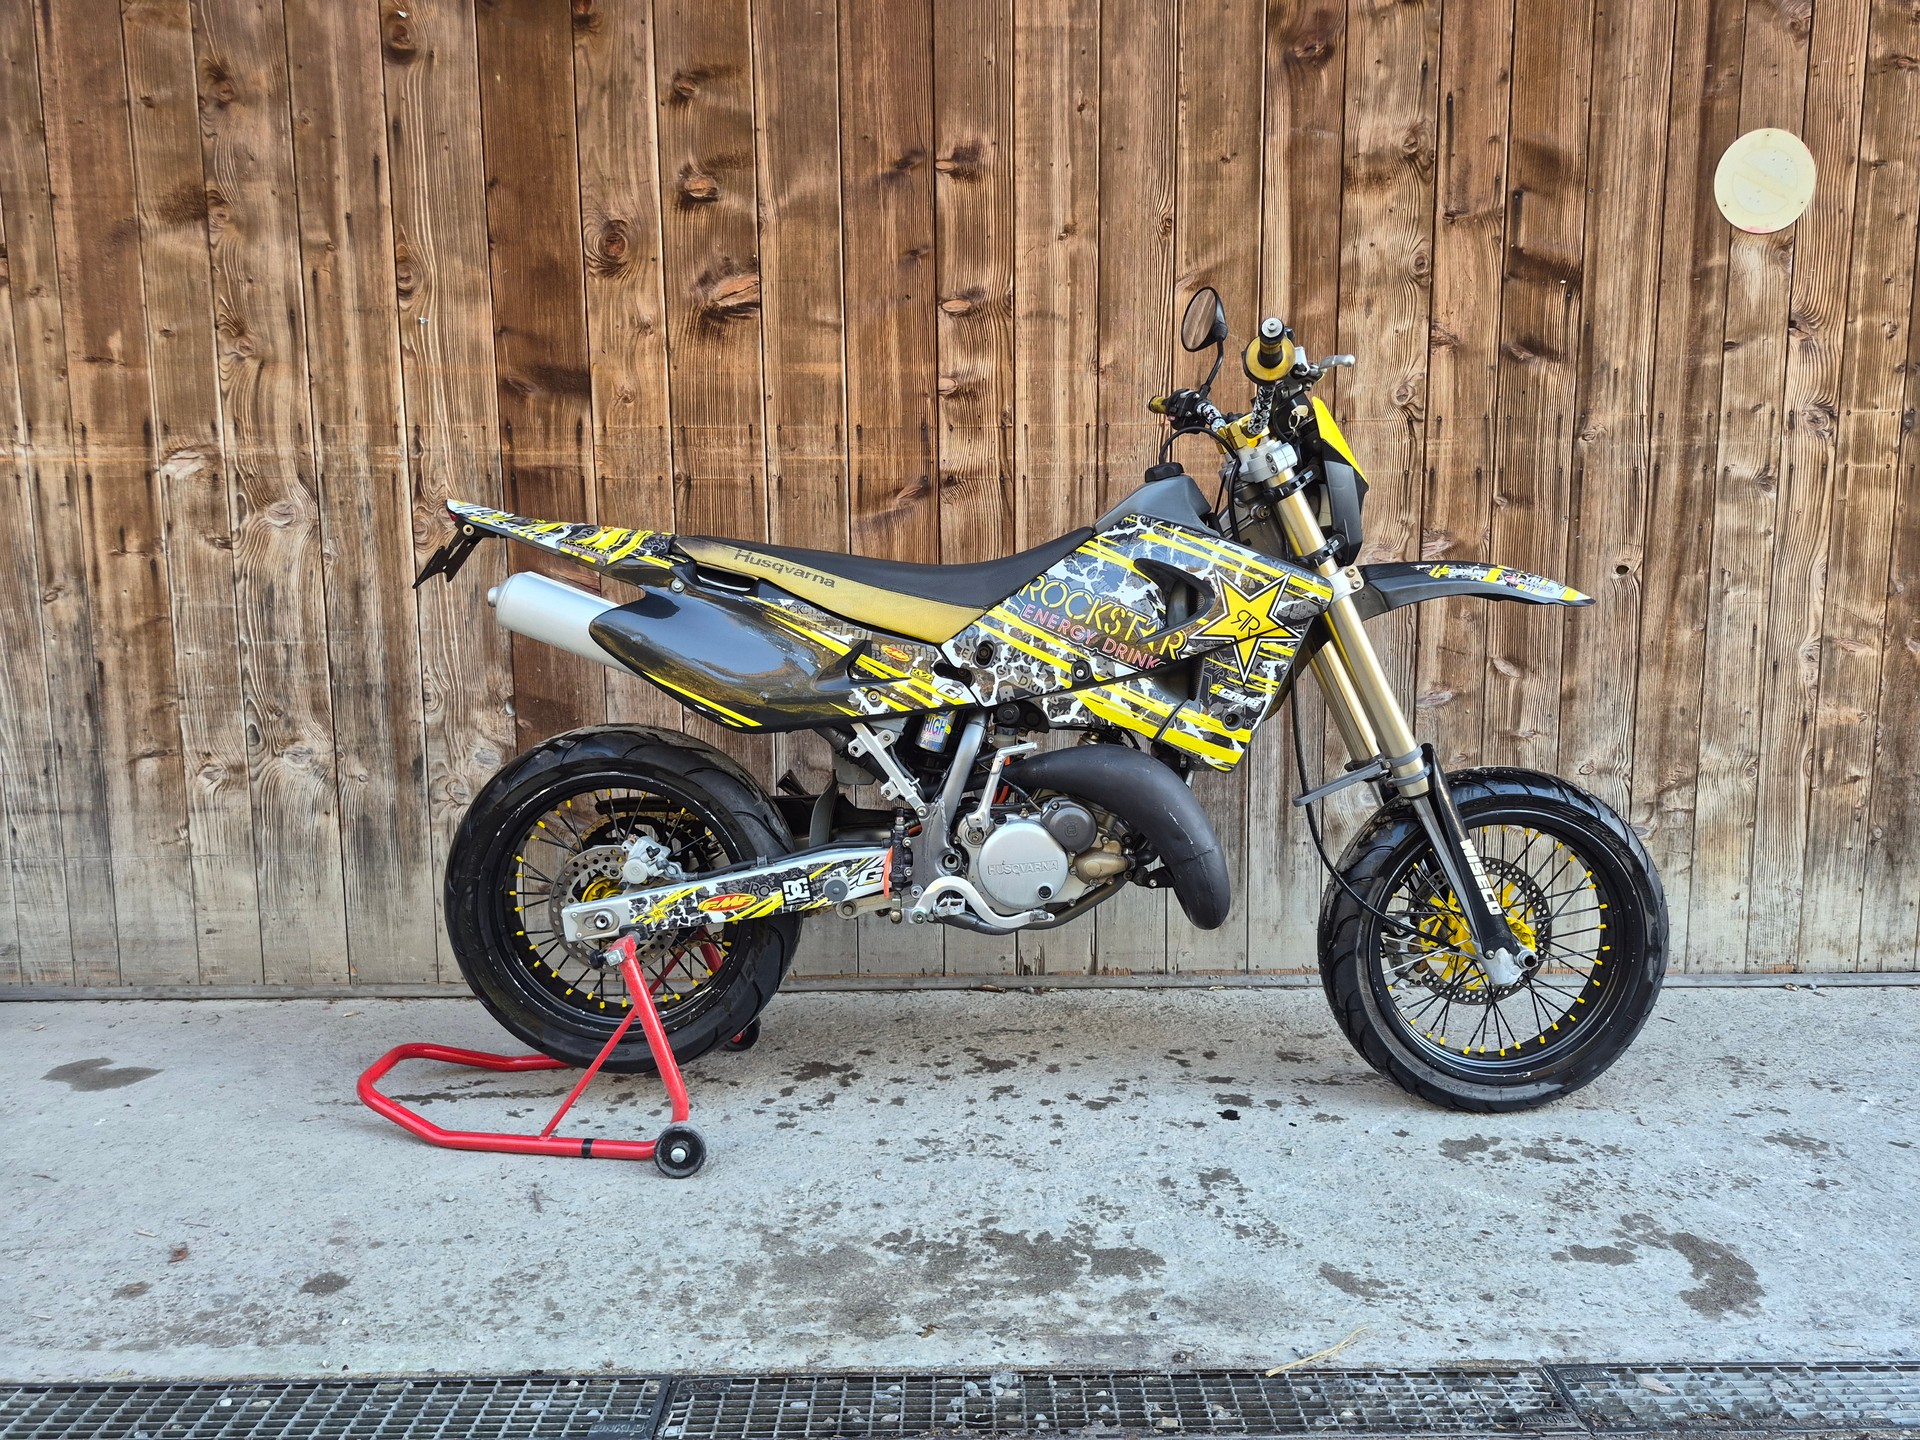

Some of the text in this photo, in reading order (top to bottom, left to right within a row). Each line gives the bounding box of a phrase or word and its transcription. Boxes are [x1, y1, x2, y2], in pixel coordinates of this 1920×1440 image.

[733, 549, 836, 588] Husqvarna
[1022, 603, 1161, 670] ENERGY DRINK
[988, 860, 1059, 876] HUSQVARNA
[1460, 839, 1503, 915] WISECO
[701, 895, 754, 911] FMF
